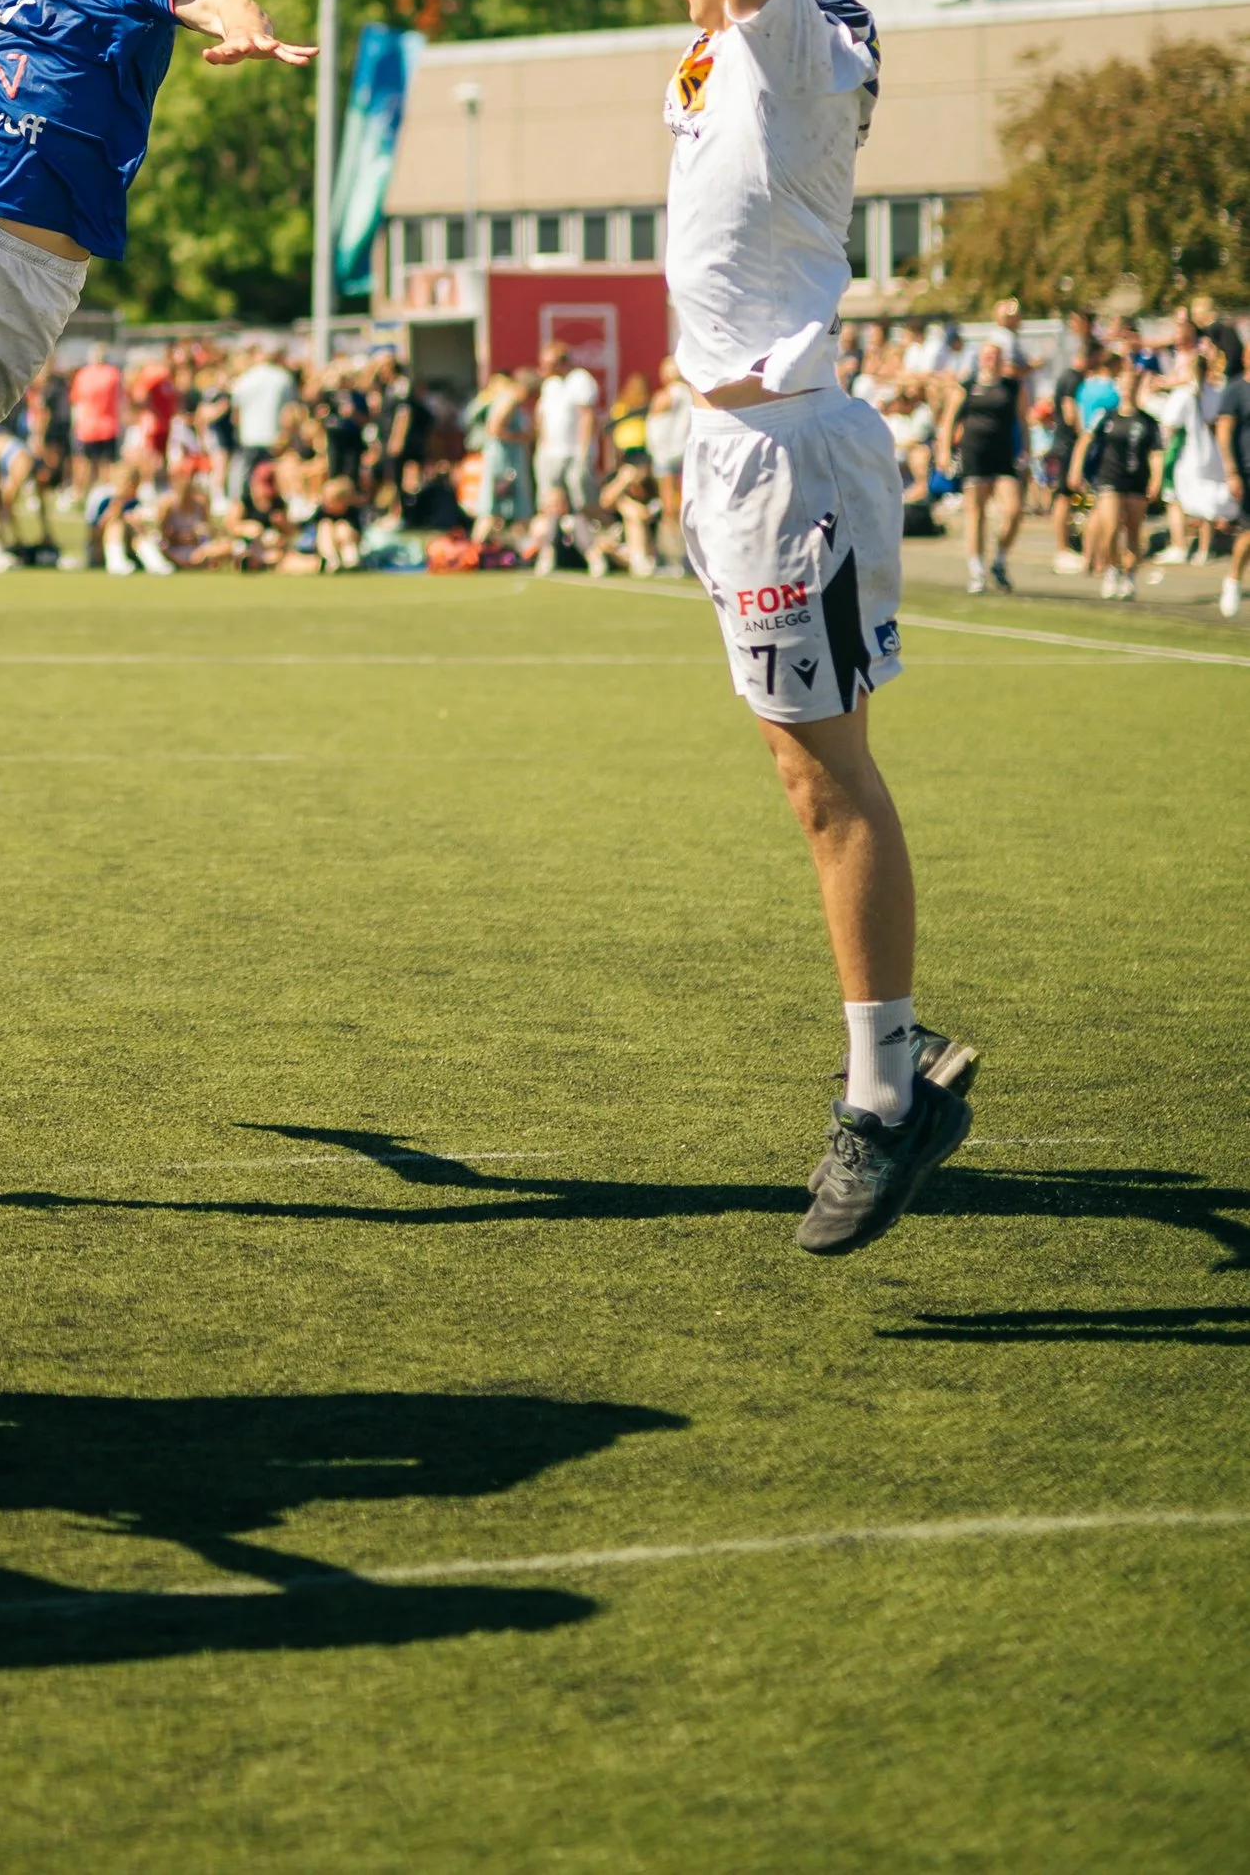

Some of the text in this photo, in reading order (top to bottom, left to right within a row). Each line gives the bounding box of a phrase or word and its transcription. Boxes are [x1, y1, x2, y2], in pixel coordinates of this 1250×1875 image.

[737, 581, 809, 616] FON
[744, 610, 811, 633] ANLEGG
[750, 644, 777, 695] 7
